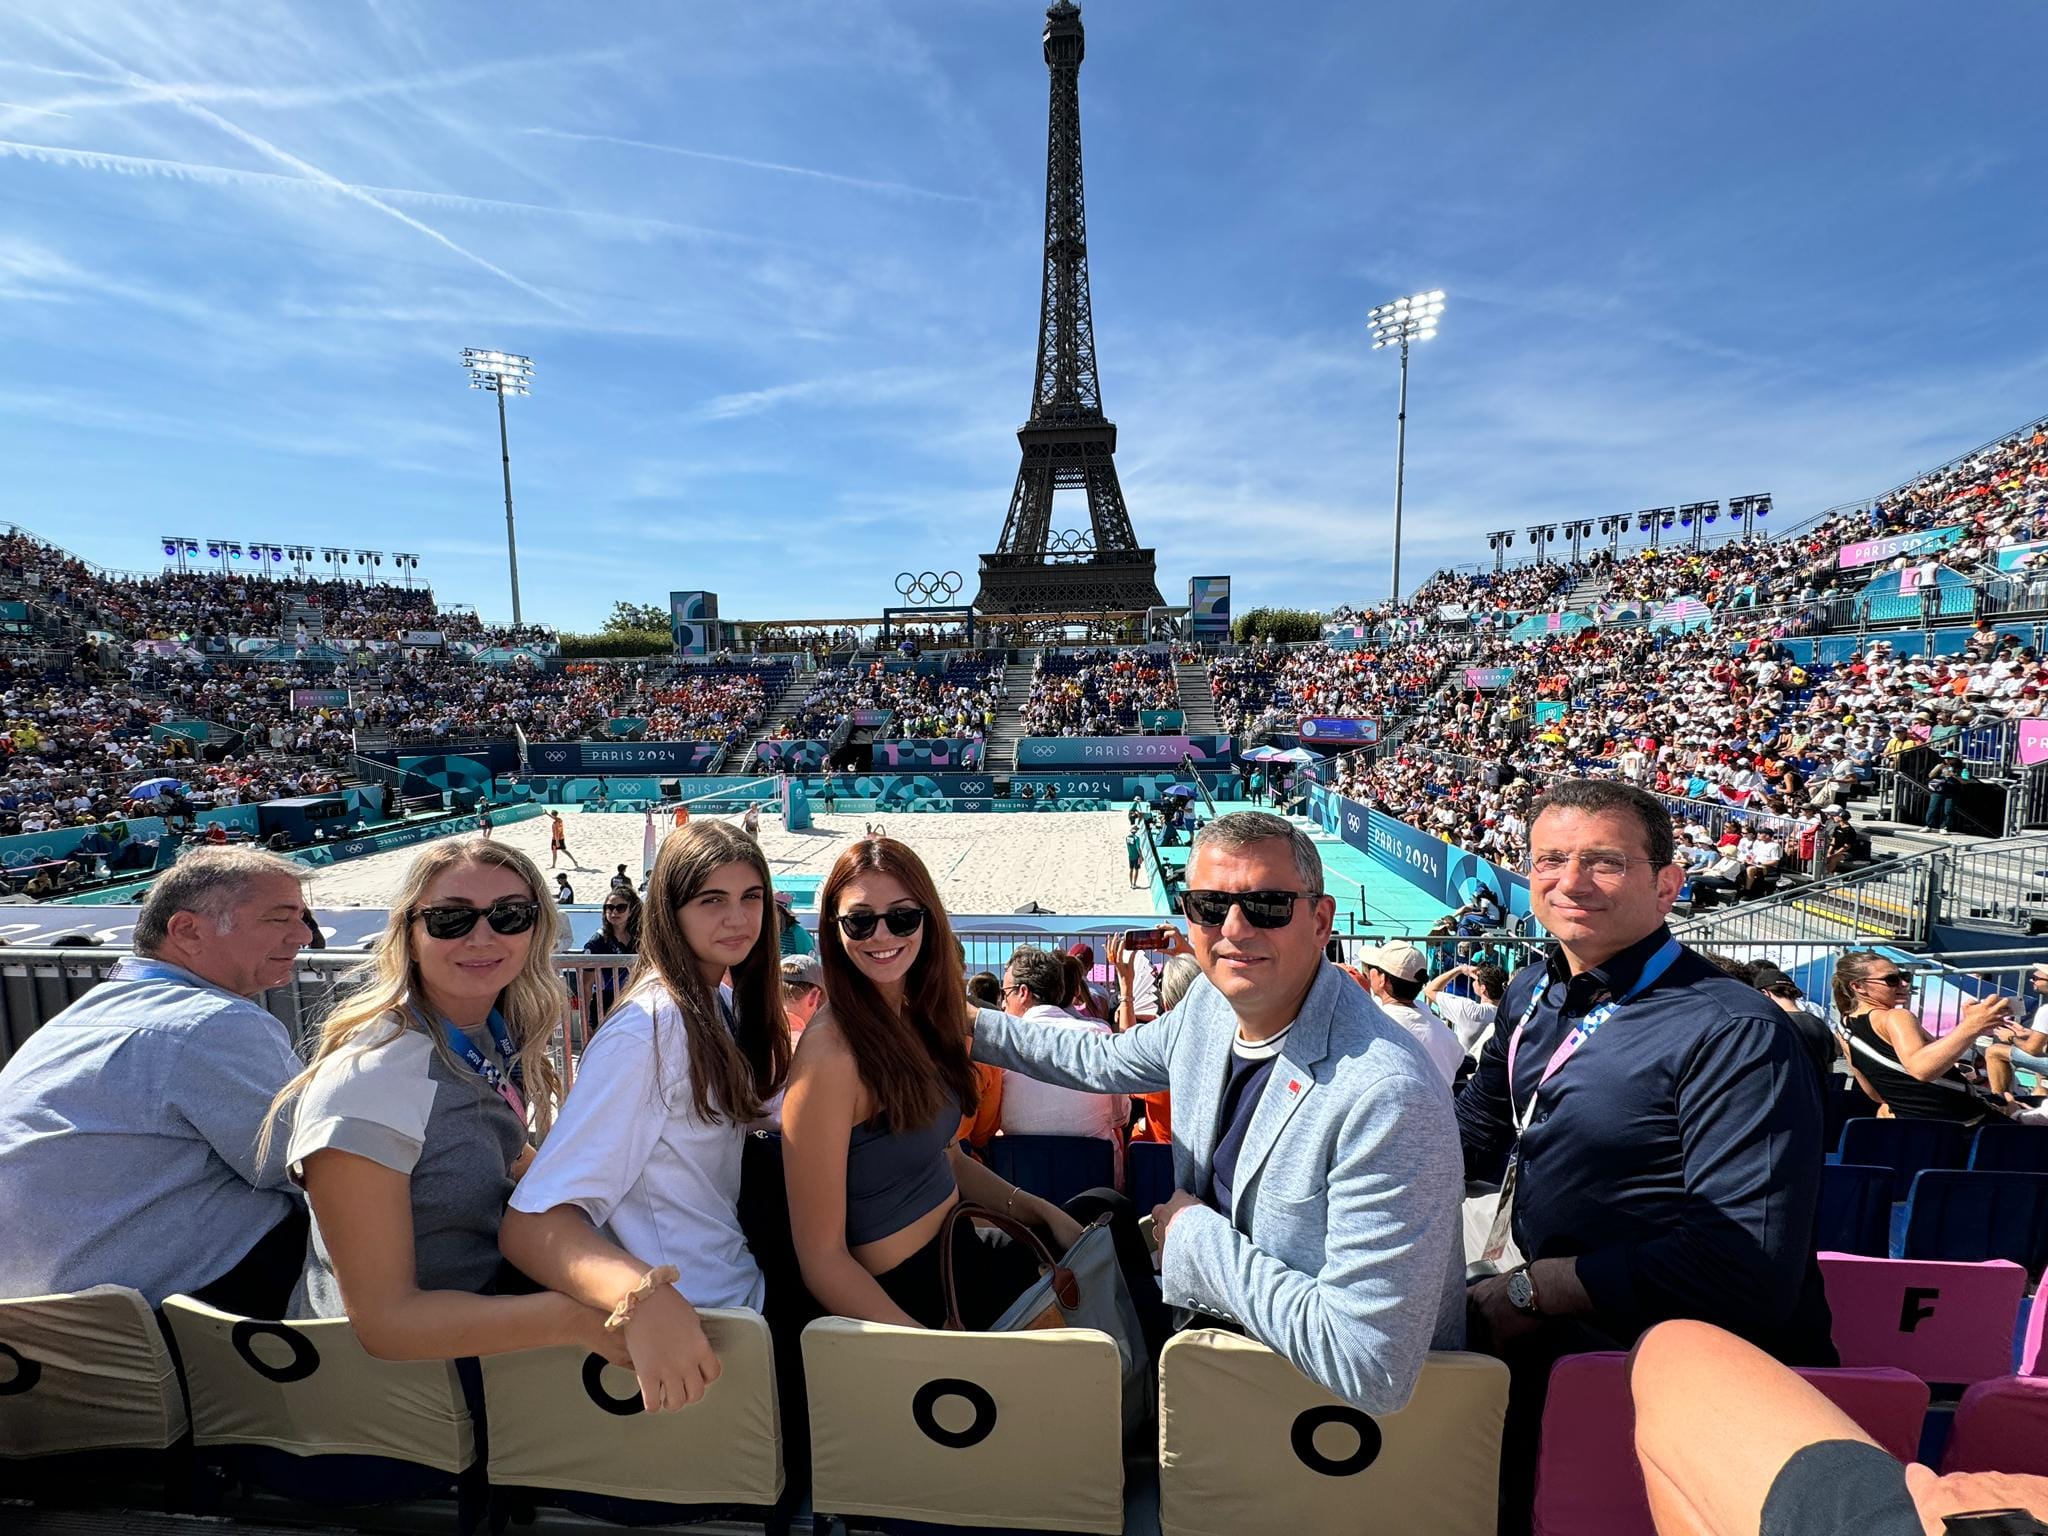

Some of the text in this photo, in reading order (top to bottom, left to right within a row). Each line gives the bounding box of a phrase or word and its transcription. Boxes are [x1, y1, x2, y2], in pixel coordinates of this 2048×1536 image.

[1855, 544, 1897, 559] PARIS
[592, 750, 675, 761] PARIS 2024
[1085, 744, 1177, 756] PARIS 2024
[1014, 782, 1111, 793] PRS 2024
[1374, 828, 1438, 879] PARIS 2024
[1898, 1286, 1940, 1334] F
